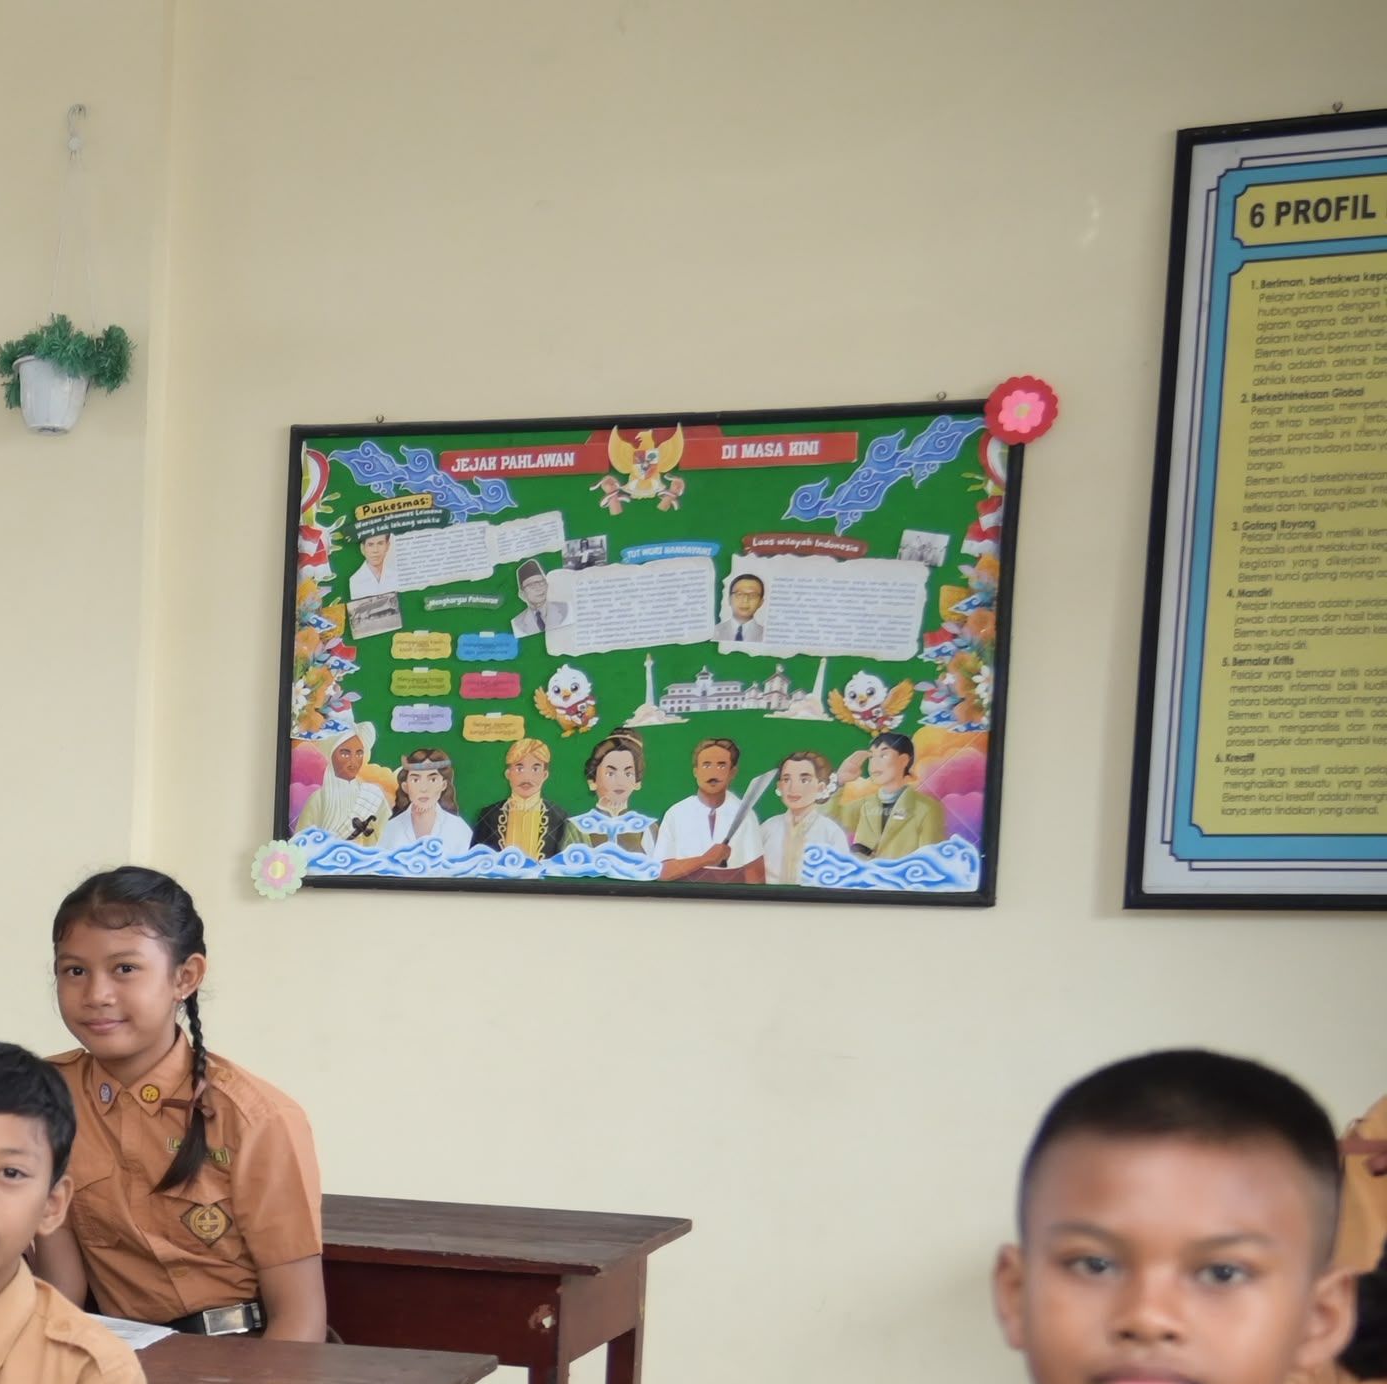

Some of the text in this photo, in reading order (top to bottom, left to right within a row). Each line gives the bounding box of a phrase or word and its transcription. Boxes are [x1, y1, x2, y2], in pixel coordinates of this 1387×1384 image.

[1249, 194, 1376, 229] 6 PROFIL
[1331, 387, 1365, 398] Global
[722, 444, 737, 459] DI
[741, 442, 785, 458] MASA
[451, 452, 575, 472] JEJAK PAHLAWAN
[362, 497, 429, 516] Puskesmas:
[357, 527, 376, 539] yang
[377, 524, 389, 532] tak
[777, 537, 812, 549] wilayah
[815, 540, 859, 553] Indonesia
